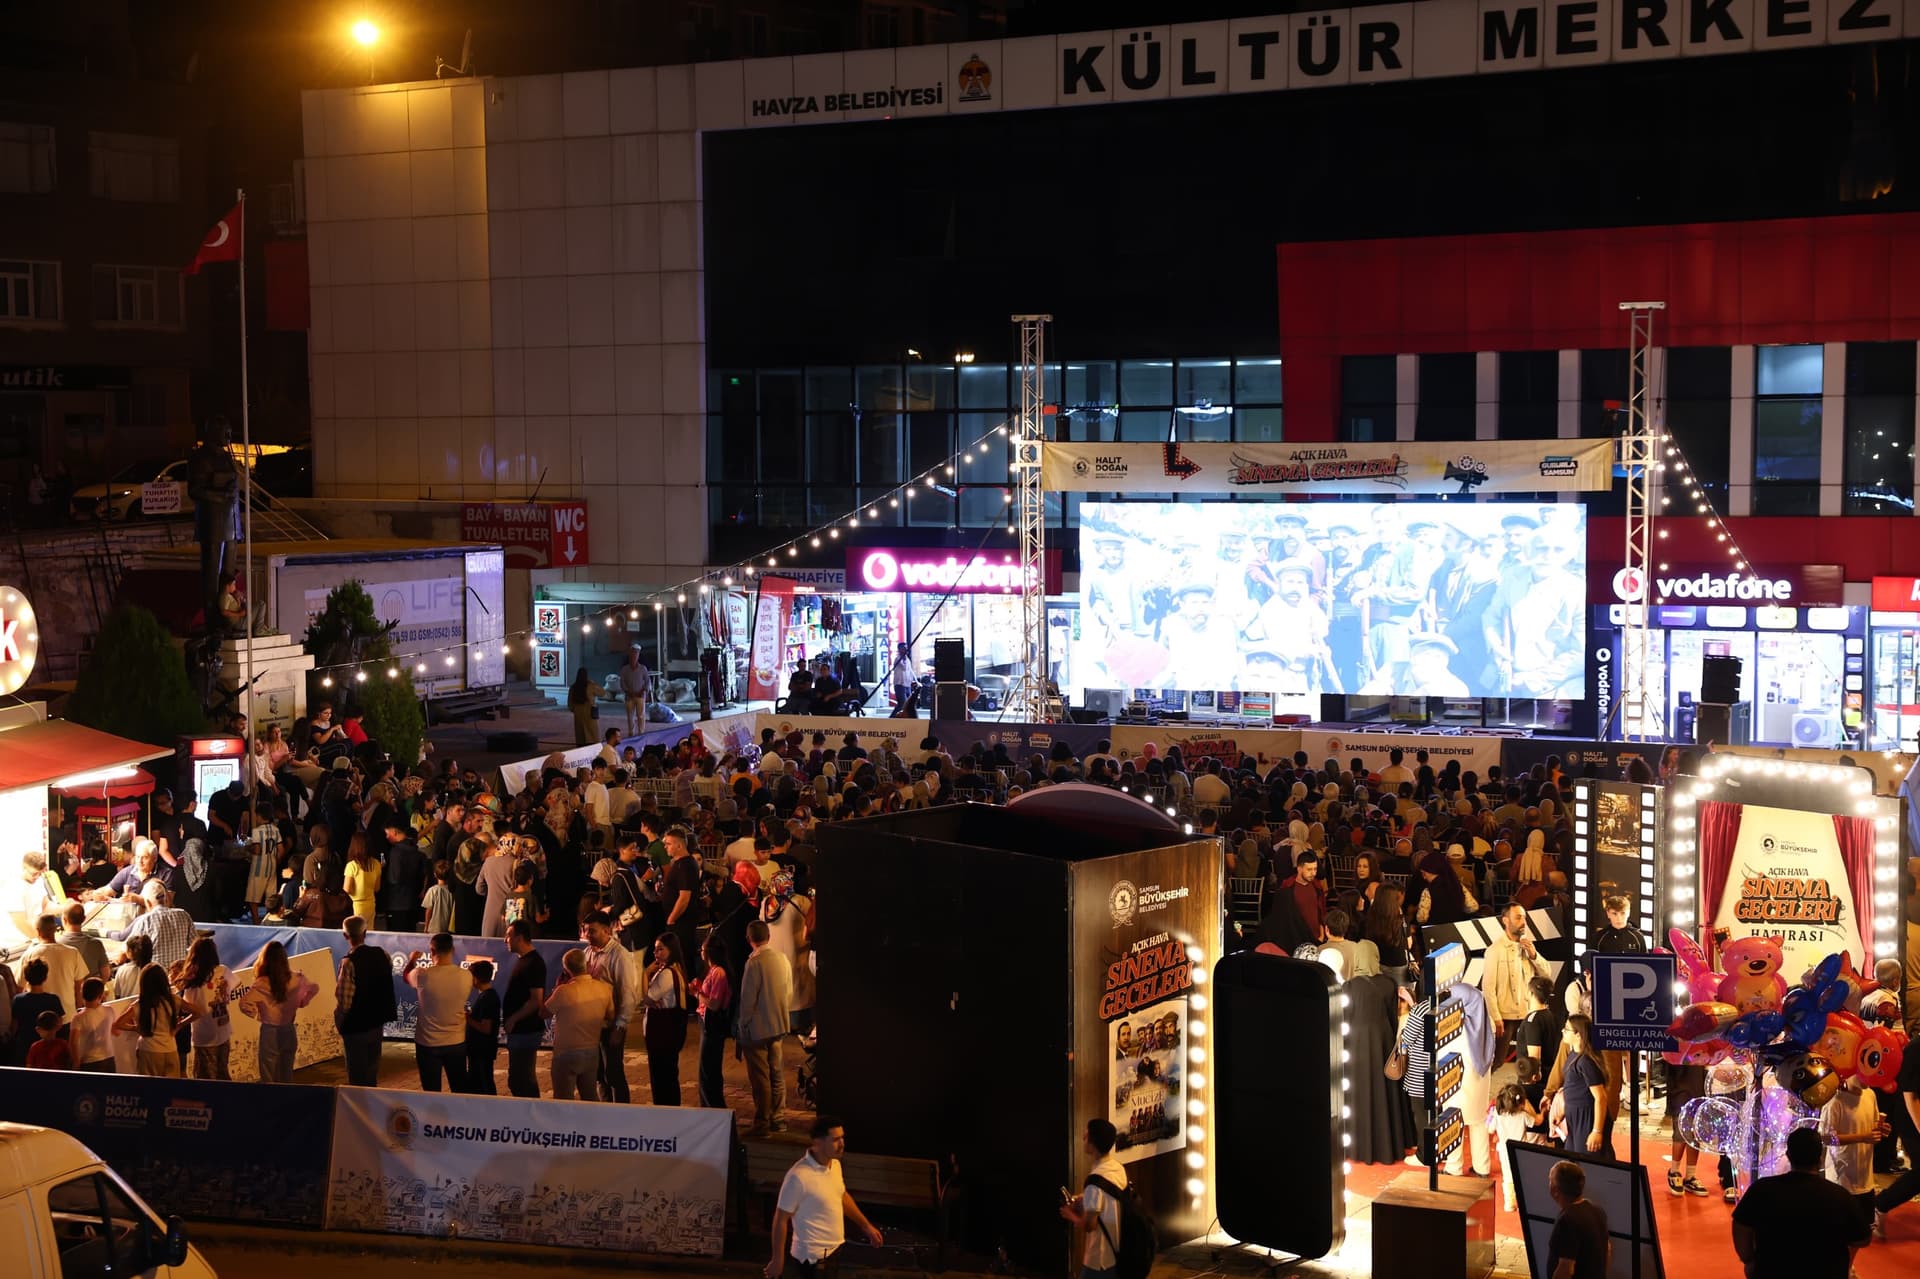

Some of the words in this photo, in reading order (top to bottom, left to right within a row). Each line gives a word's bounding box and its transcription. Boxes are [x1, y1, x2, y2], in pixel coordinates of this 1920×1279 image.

[1063, 17, 1401, 95] KÜLTÜR
[1483, 0, 1892, 63] MERKEZ
[752, 97, 819, 116] HAVZA
[825, 82, 943, 111] BELEDİYESİ
[1290, 450, 1315, 462] AÇIK
[1319, 449, 1348, 460] HAVA
[466, 508, 491, 522] BAY
[504, 508, 546, 522] BAYAN
[554, 508, 585, 532] WC
[464, 526, 550, 541] TUVALETLER
[901, 557, 1039, 588] vodafone
[411, 581, 462, 610] LIFE
[1657, 573, 1792, 600] vodafone
[1345, 744, 1378, 752] SAMSUN
[1429, 747, 1474, 755] BELEDİYESİ
[1768, 867, 1787, 878] AÇIK
[1787, 867, 1809, 877] HAVA
[1139, 885, 1160, 893] SAMSUN
[1139, 886, 1189, 906] BÜYÜKŞEHİR
[1742, 872, 1829, 899] SİNEMA
[1139, 902, 1167, 913] BELEDİYESİ
[1734, 895, 1840, 922] GECELERİ
[1131, 940, 1149, 955] AÇIK
[1149, 932, 1169, 946] HAVA
[1751, 929, 1824, 942] HATIRASI
[1105, 940, 1186, 991] SİNEMA
[1611, 962, 1657, 1020] P
[1599, 1028, 1640, 1038] ENGELLİ
[1606, 1040, 1632, 1048] PARK
[1634, 1040, 1664, 1049] ALANI
[423, 1125, 487, 1142] SAMSUN
[490, 1126, 587, 1148] BÜYÜKŞEHİR
[590, 1135, 678, 1153] BELEDİYESİ
